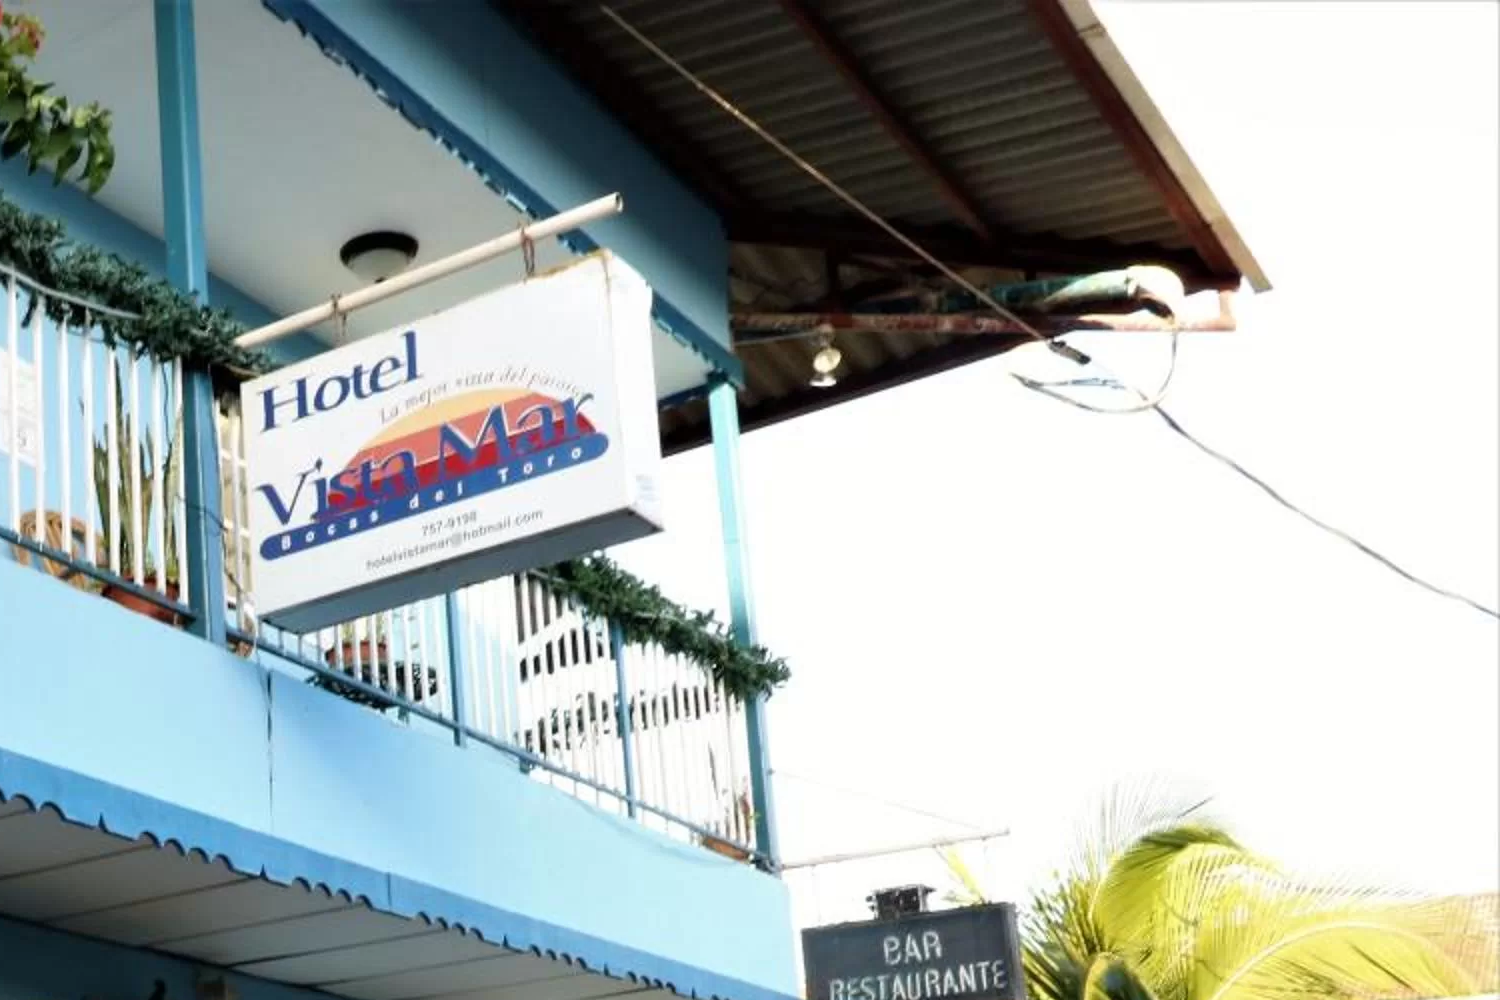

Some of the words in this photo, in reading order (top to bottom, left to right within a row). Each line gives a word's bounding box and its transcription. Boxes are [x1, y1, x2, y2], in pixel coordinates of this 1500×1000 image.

[261, 330, 424, 433] Hotel
[380, 406, 399, 424] La
[405, 383, 447, 409] mejor
[500, 366, 527, 383] del
[255, 447, 419, 527] Vista
[436, 392, 595, 481] Mar
[280, 509, 379, 550] Bocas
[409, 480, 464, 510] del
[498, 447, 582, 484] Toro
[882, 930, 943, 966] BAR
